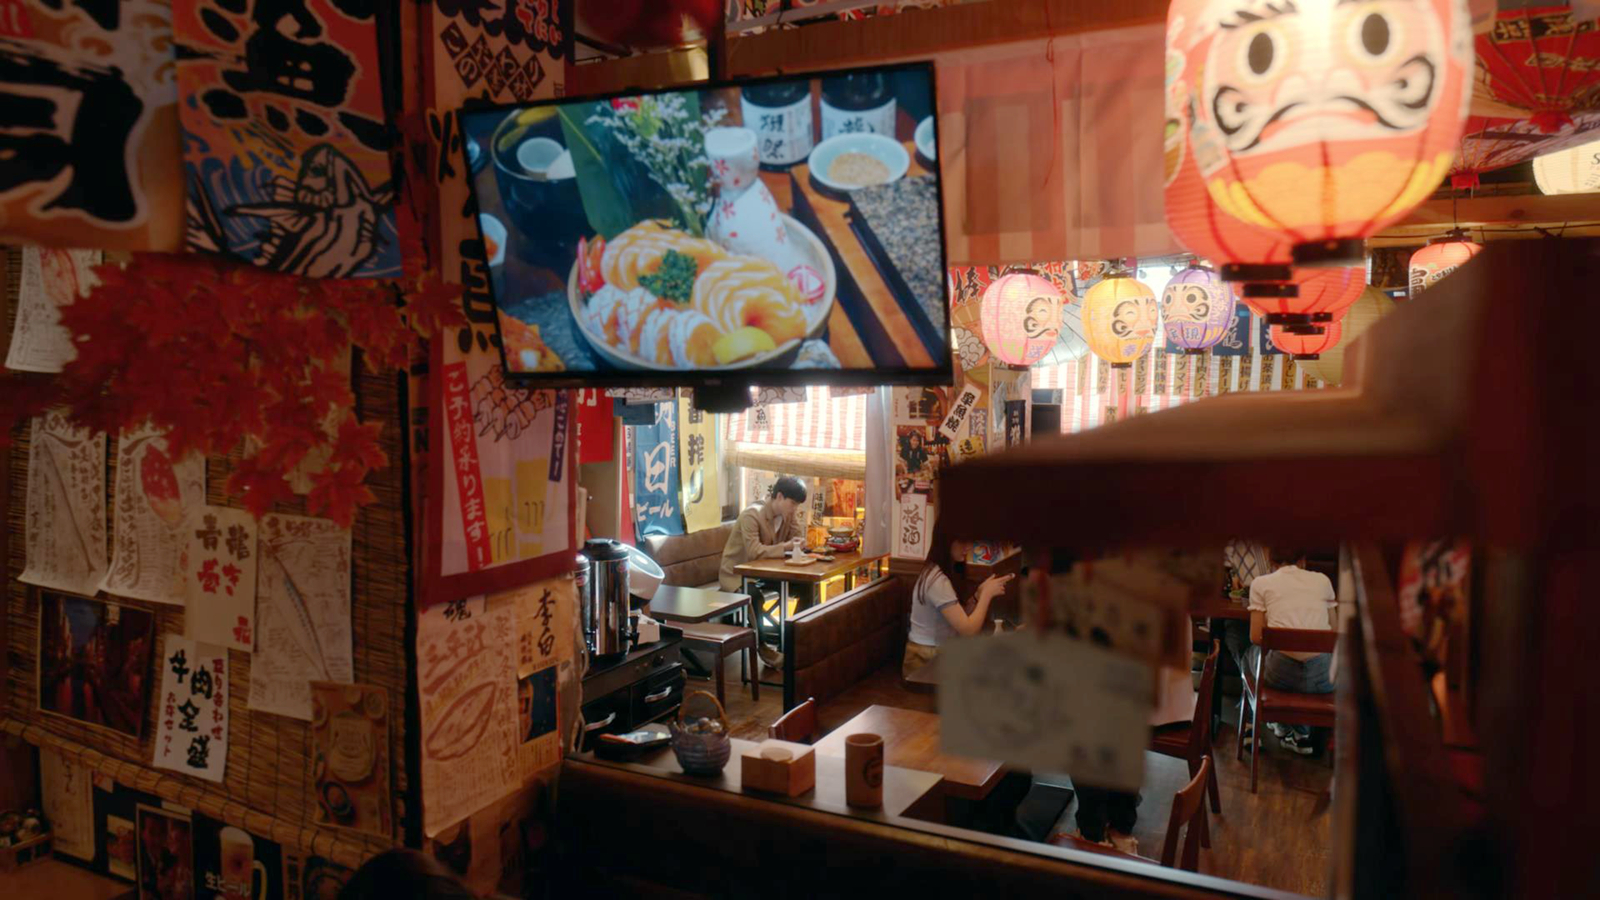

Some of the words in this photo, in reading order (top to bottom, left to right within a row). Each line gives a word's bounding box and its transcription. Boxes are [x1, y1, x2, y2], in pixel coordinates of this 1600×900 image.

[637, 498, 674, 522] ビール
[204, 870, 252, 898] 生ビール
